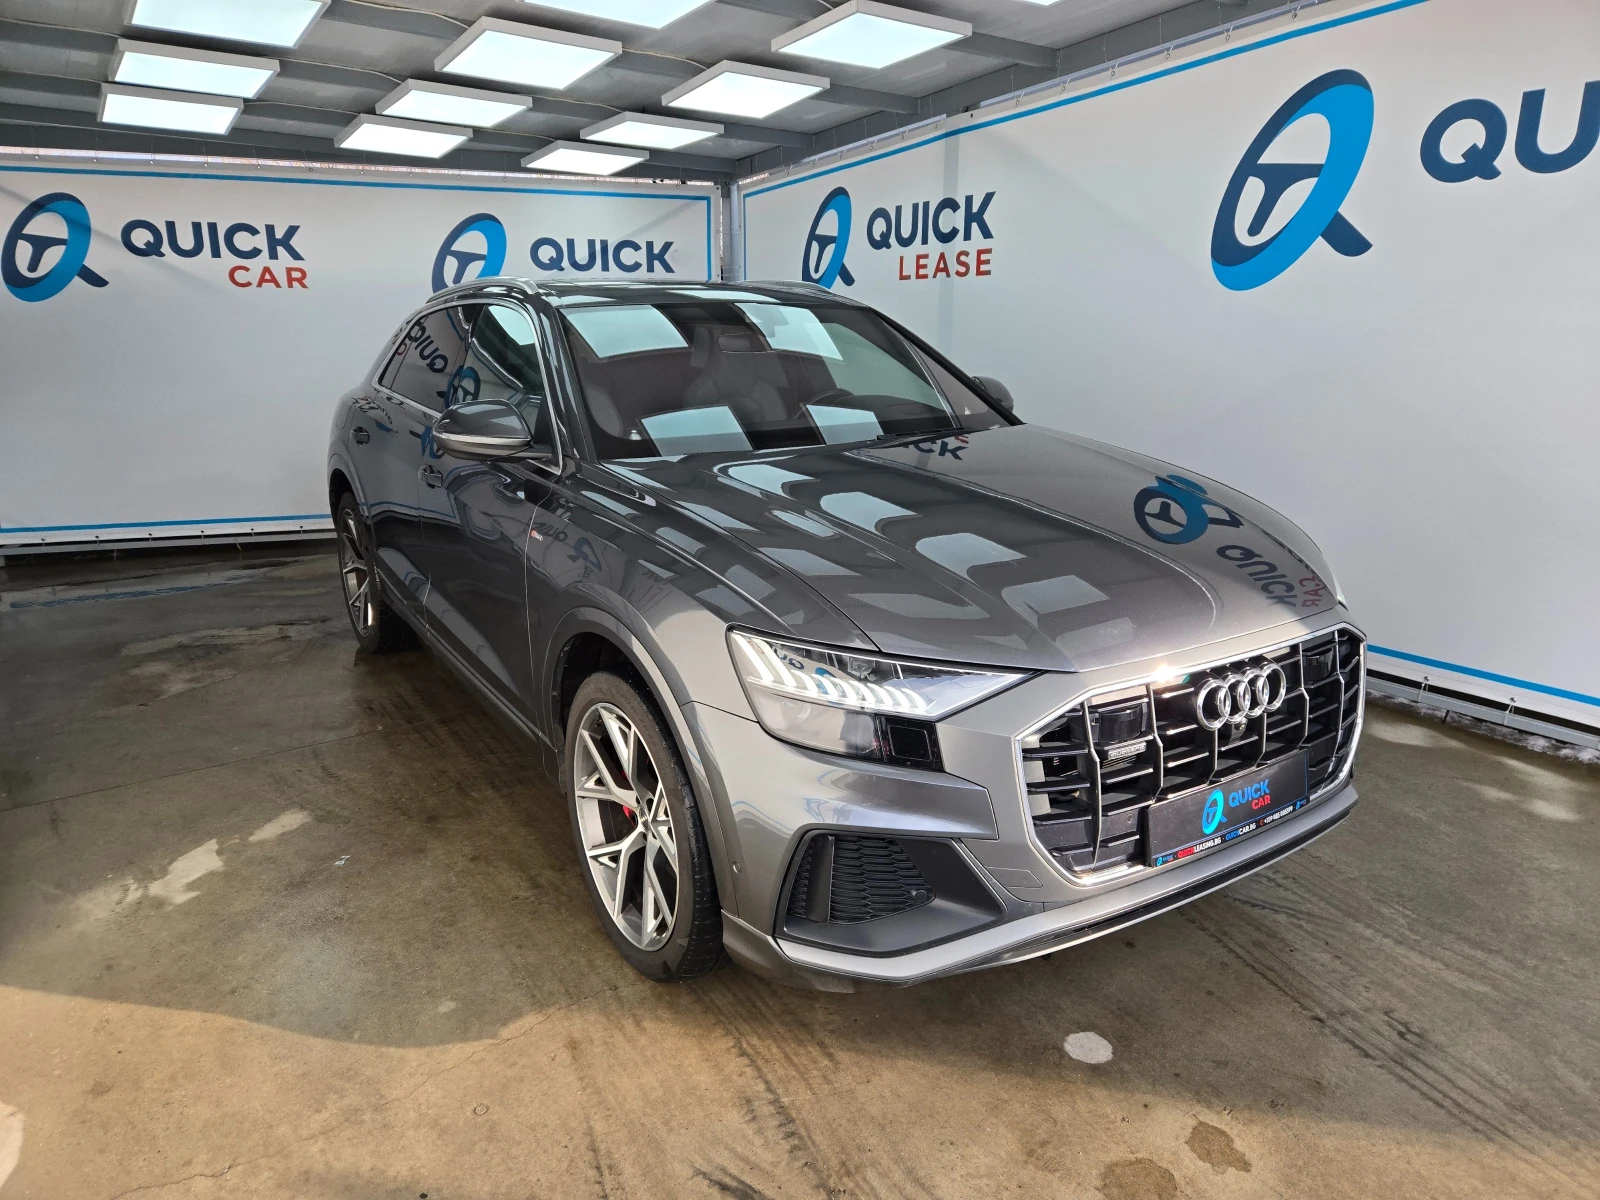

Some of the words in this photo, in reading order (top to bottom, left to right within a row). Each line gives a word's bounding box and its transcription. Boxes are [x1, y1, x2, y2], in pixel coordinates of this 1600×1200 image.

[866, 191, 997, 250] QUICK
[120, 219, 306, 261] QUICK
[529, 237, 676, 274] QUICK
[228, 265, 309, 289] CAR
[899, 248, 993, 281] LEASE
[1228, 779, 1270, 808] QUICK
[1251, 794, 1271, 810] CAR
